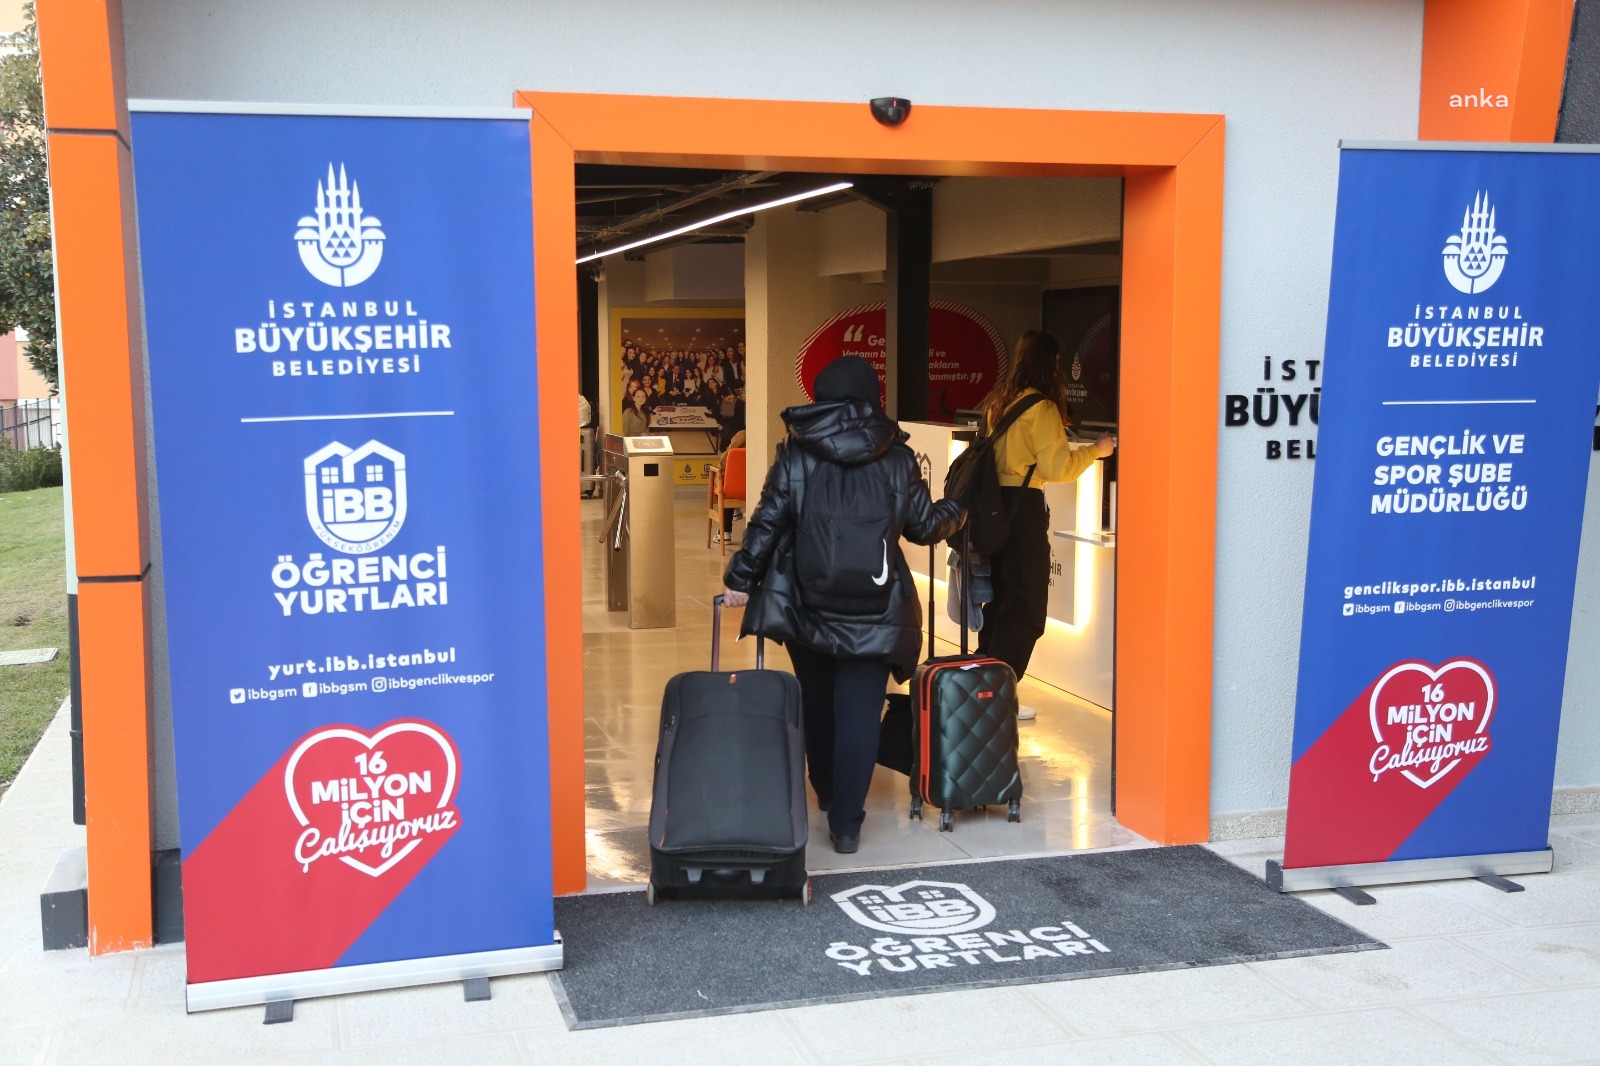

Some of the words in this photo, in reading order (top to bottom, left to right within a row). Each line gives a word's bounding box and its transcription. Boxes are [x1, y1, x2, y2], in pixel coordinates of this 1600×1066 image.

[268, 299, 418, 319] İSTANBUL
[1415, 304, 1522, 320] İSTANBUL
[234, 321, 452, 354] BÜYÜKŞEHİR
[1387, 322, 1544, 350] BÜYÜKŞEHİR
[272, 354, 420, 377] BELEDİYESİ
[1410, 351, 1518, 368] BELEDİYESİ
[1376, 429, 1487, 460] GENÇLİK
[1492, 434, 1526, 455] VE
[1373, 464, 1441, 486] SPOR
[1447, 462, 1513, 489] ŞUBE
[1370, 486, 1528, 515] MÜDÜRLÜĞÜ
[271, 545, 447, 590] ÖĞRENCİ
[273, 581, 448, 617] YURTLARI
[1344, 576, 1537, 599] genclikspor.ibb.istanbul
[1355, 604, 1391, 615] ibbgsm
[1406, 602, 1441, 613] ibbgsm
[1455, 599, 1535, 612] ibbgenclikvespor
[267, 647, 456, 681] yurt.ibb.istanbul
[247, 687, 298, 701] ibbgsm
[318, 681, 368, 695] ibbgsm
[388, 672, 495, 690] ibbgenclikvespor
[1421, 683, 1445, 703] 16
[354, 750, 388, 776] 16
[1369, 737, 1489, 783] Çalışıyoruz
[294, 810, 458, 874] Çalışıyoruz
[824, 920, 1091, 961] ÖĞRENCİ
[836, 938, 1112, 977] YURTLARI
